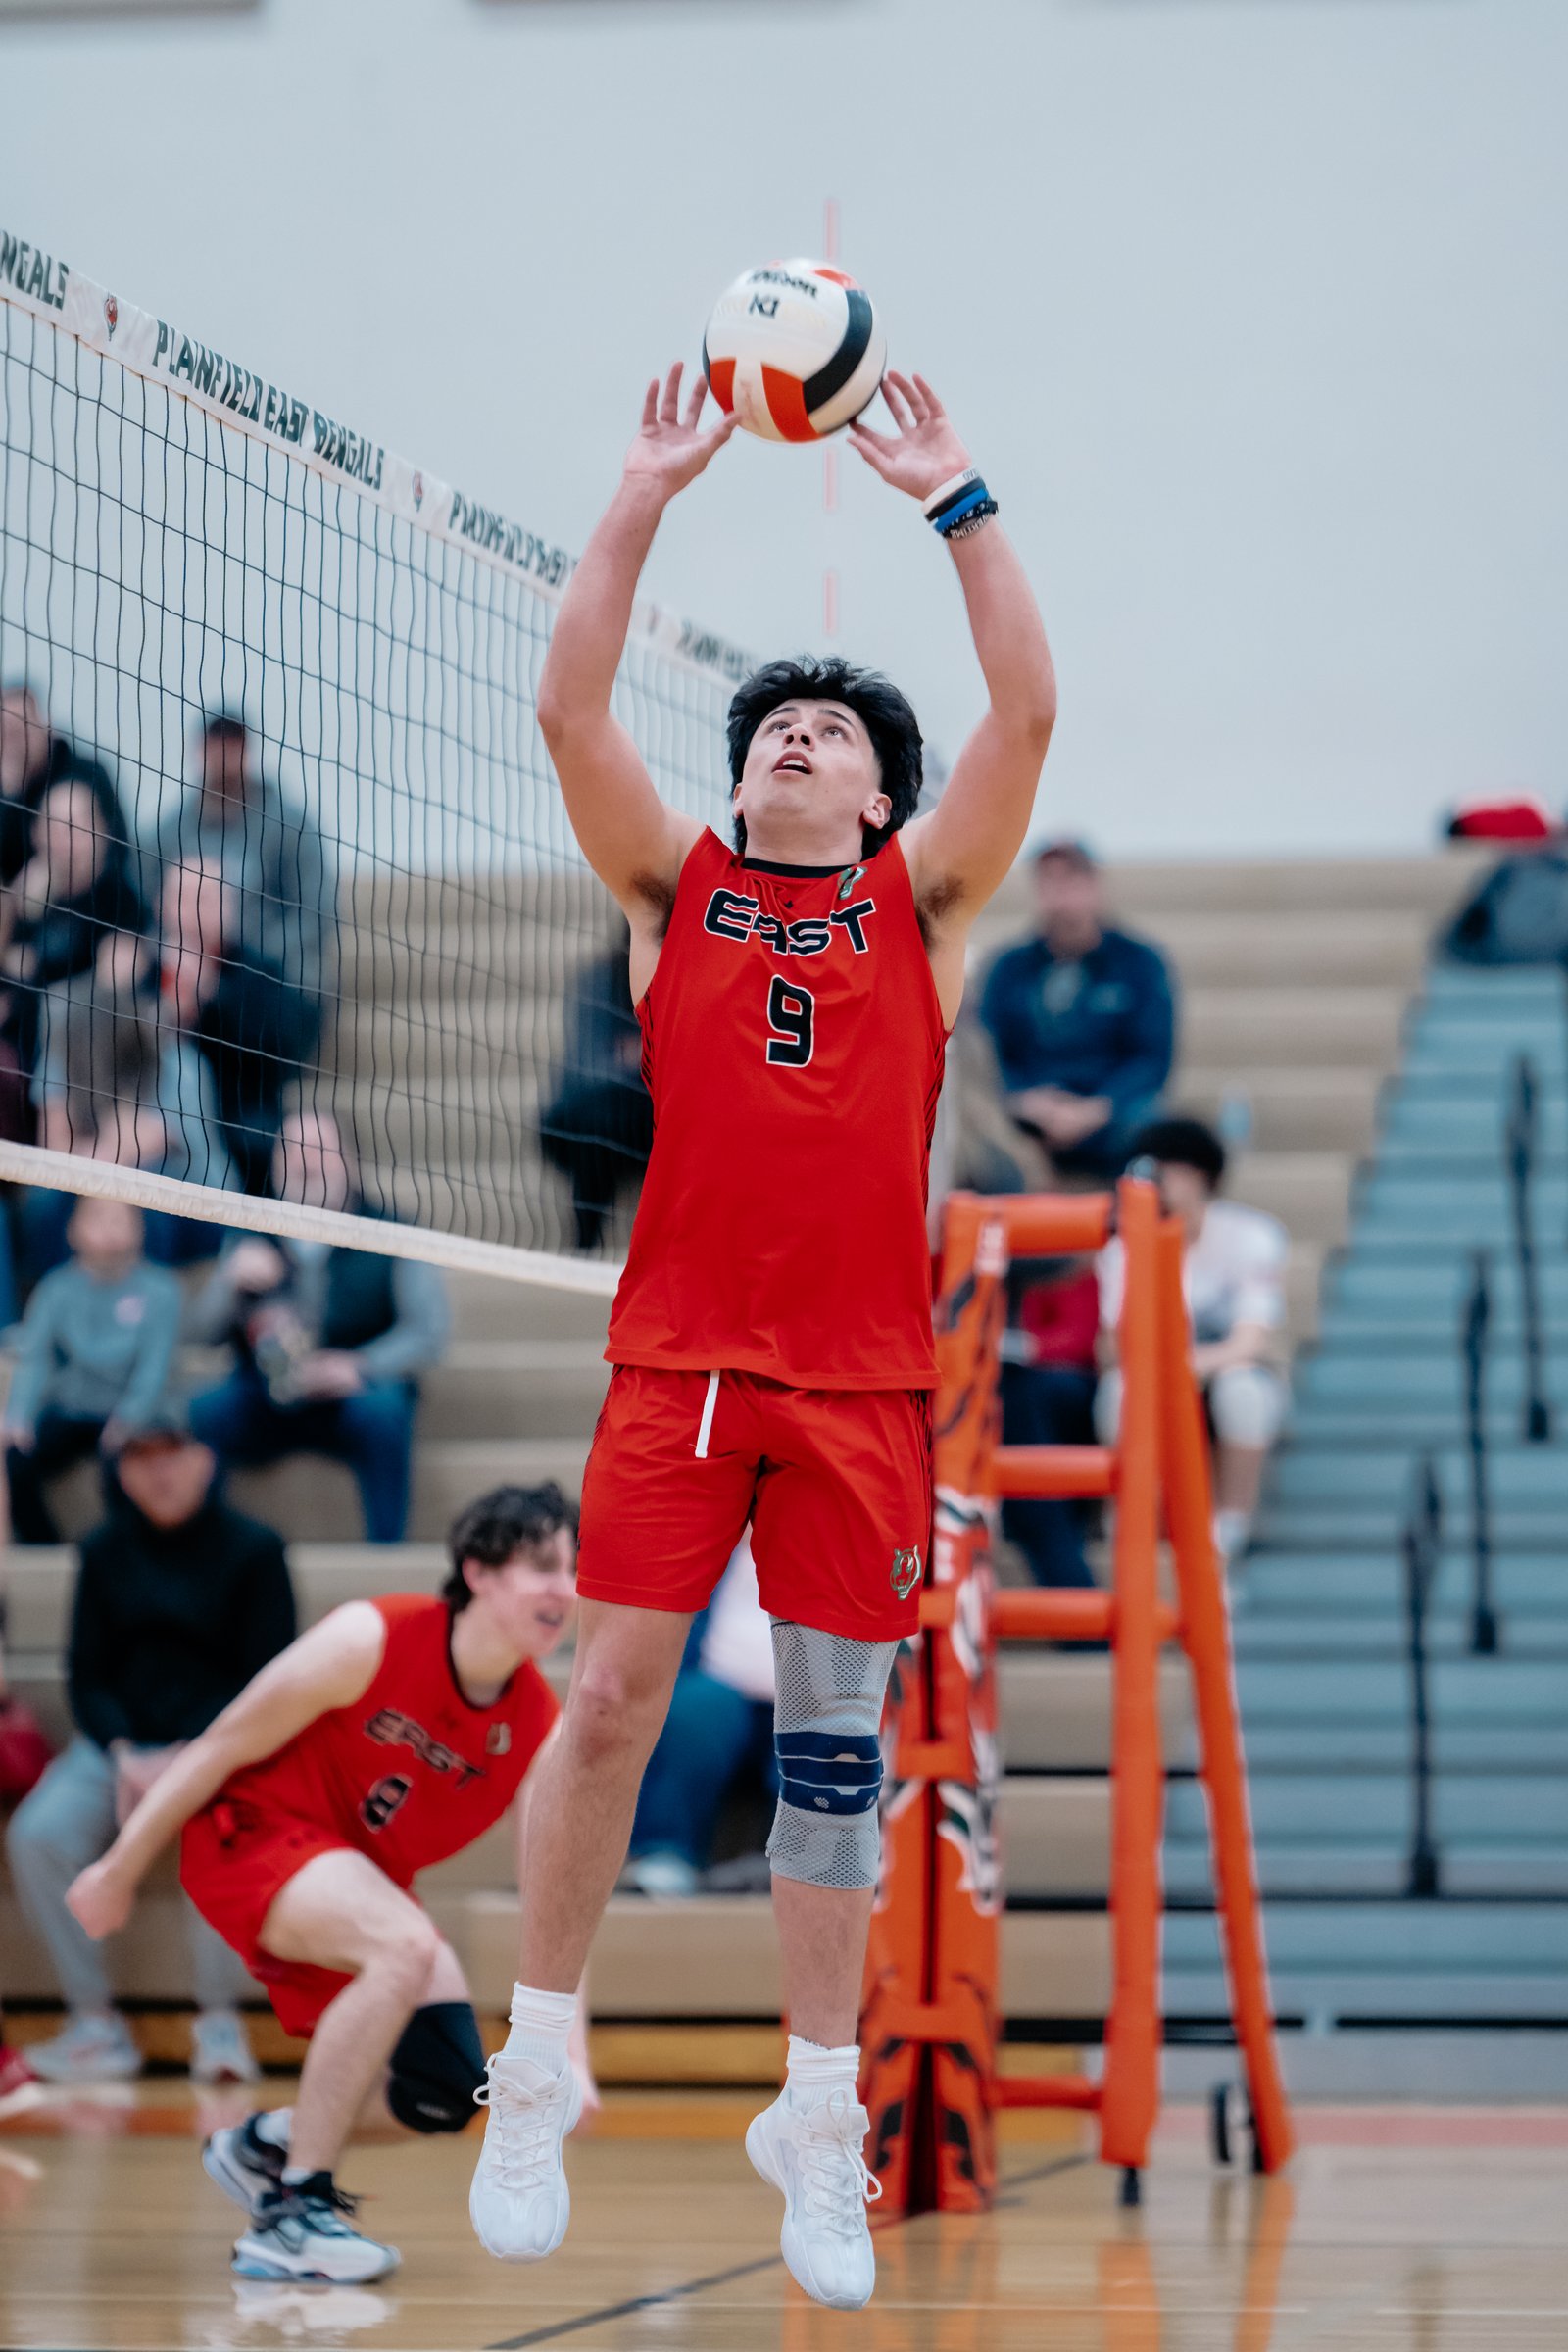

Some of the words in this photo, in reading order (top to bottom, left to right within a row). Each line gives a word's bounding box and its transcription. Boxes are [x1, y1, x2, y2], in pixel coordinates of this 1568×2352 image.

[264, 383, 310, 448] EAST
[313, 409, 385, 491] BENGALS
[704, 887, 877, 957] EAST
[766, 973, 815, 1068] 9
